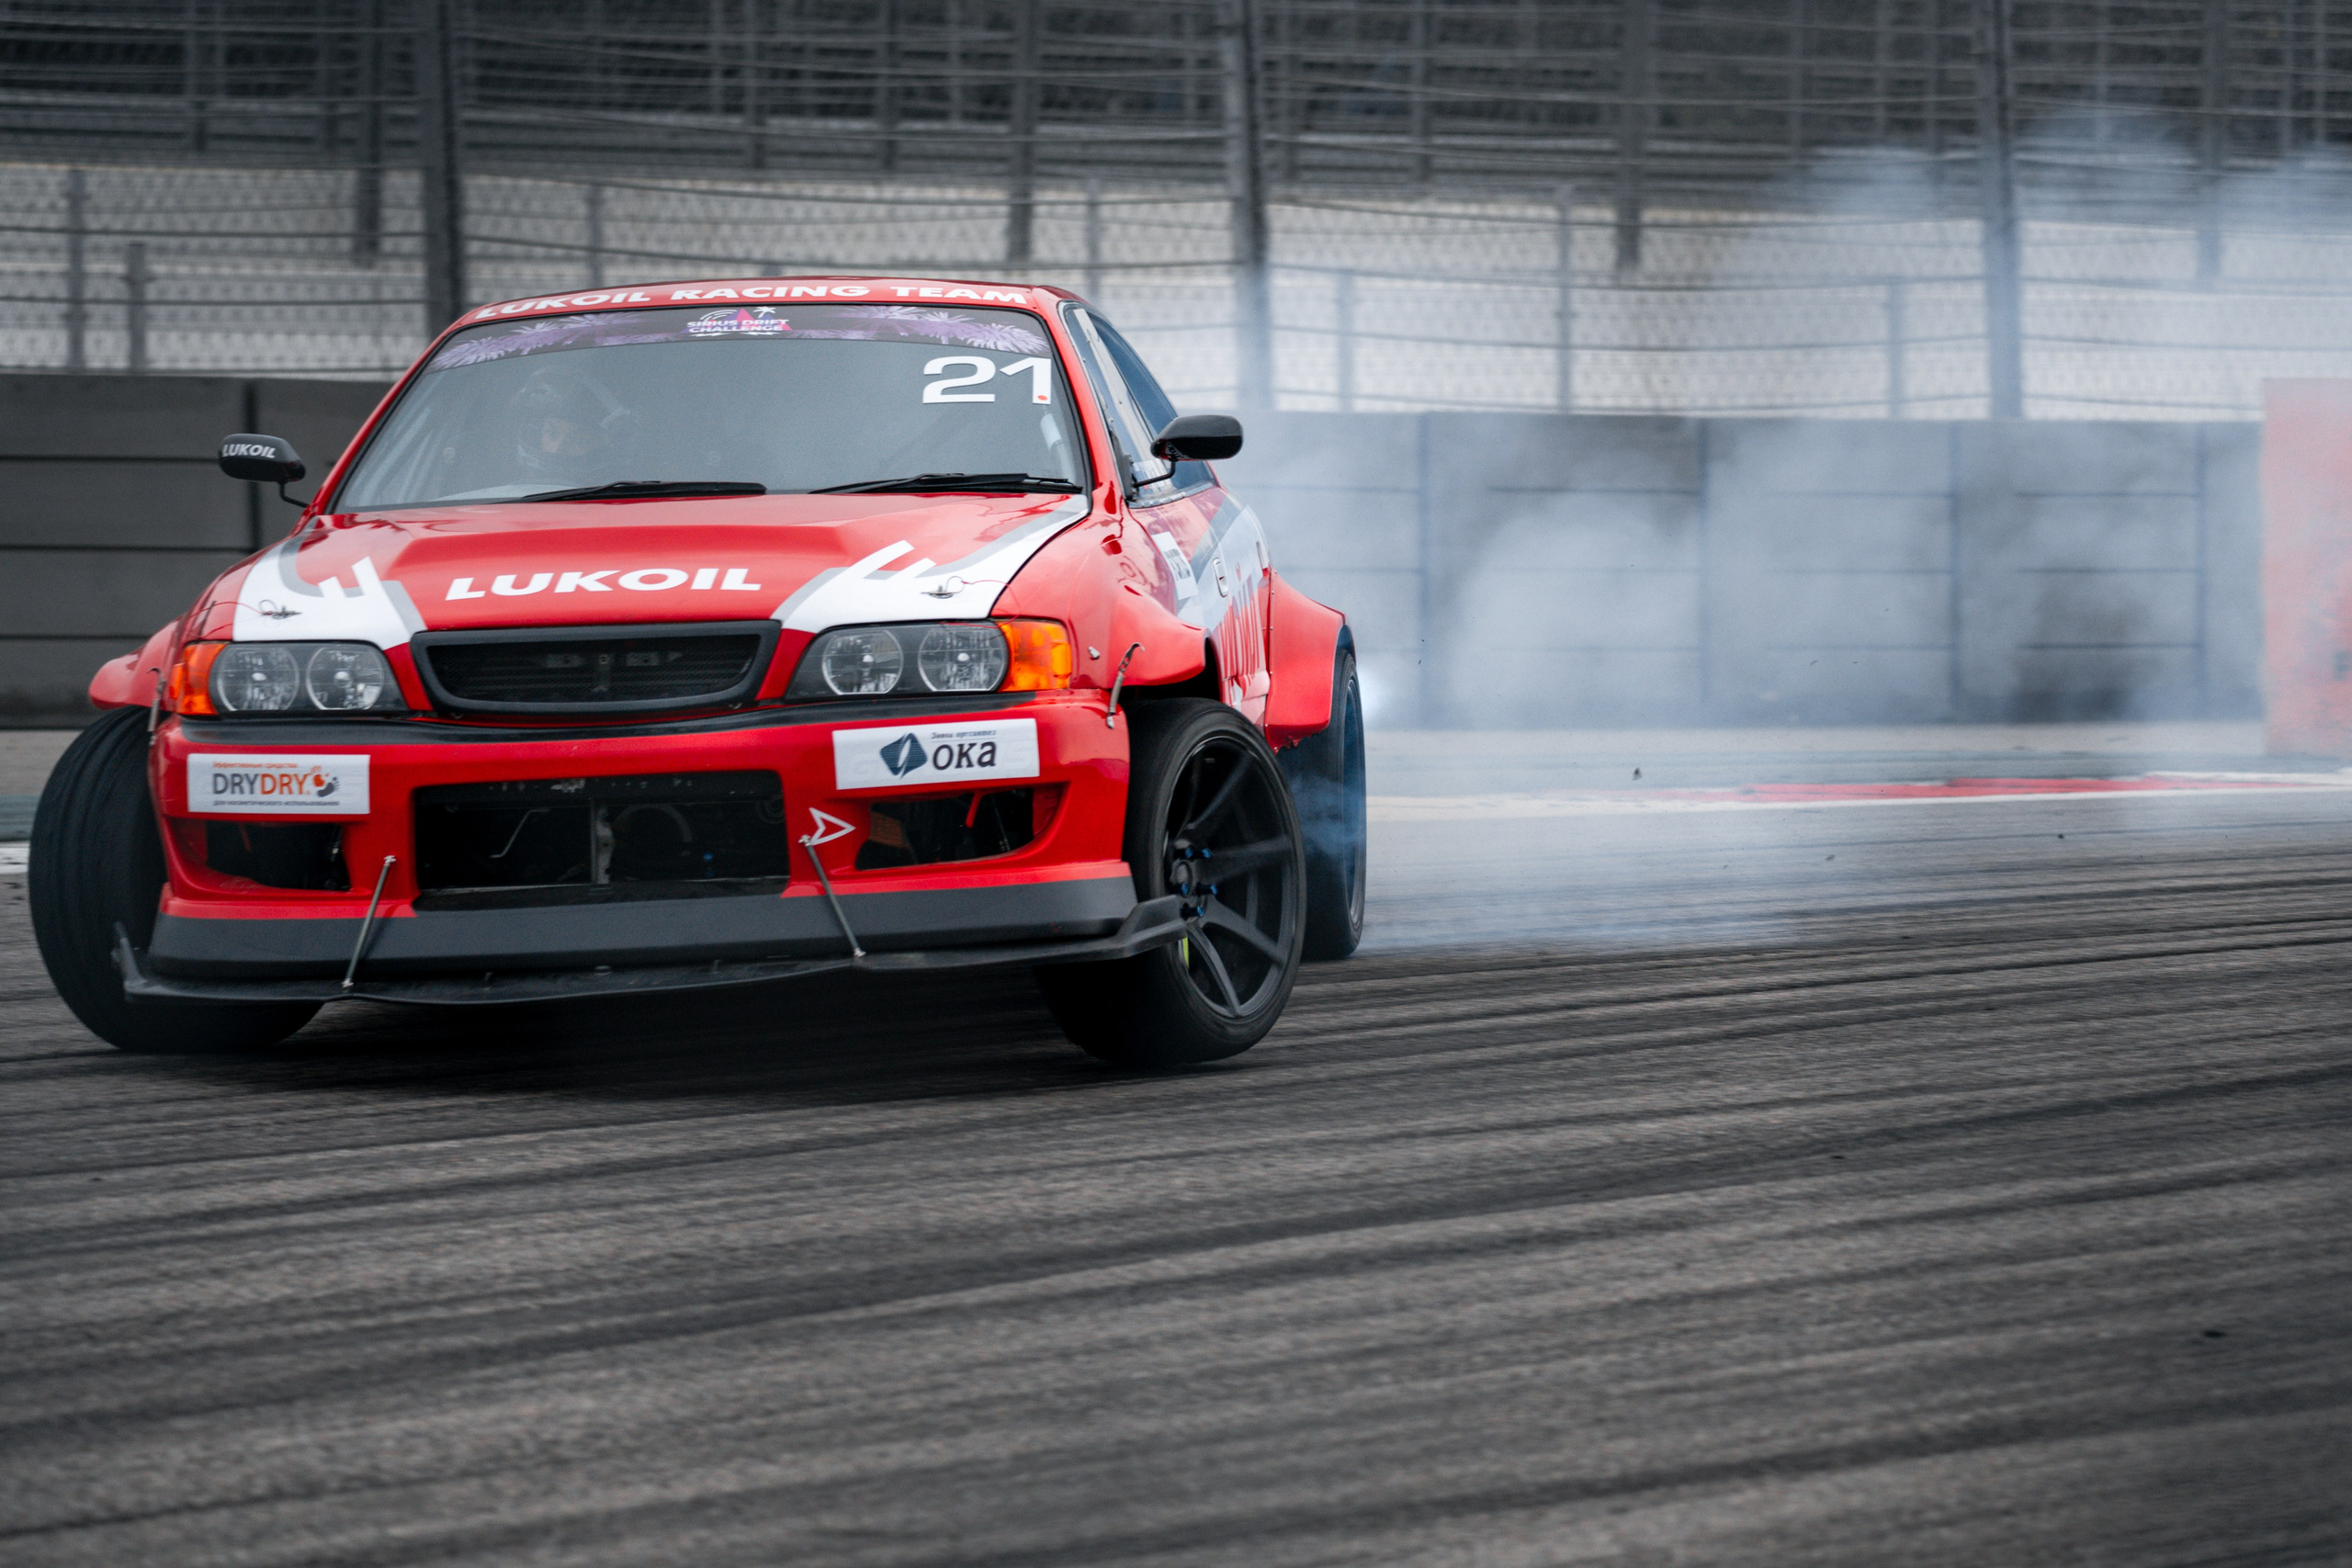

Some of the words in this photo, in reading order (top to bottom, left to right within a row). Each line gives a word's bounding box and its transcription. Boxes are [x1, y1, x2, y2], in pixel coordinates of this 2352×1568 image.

[475, 291, 651, 319] LUKOIL
[670, 286, 870, 300] RACING
[890, 286, 1027, 304] TEAM
[686, 320, 738, 328] SIRIUS
[741, 319, 789, 327] DRIFT
[688, 325, 785, 333] CHALLENGE
[922, 355, 1051, 405] 21
[221, 444, 276, 458] LUKOIL
[445, 568, 762, 601] LUKOIL
